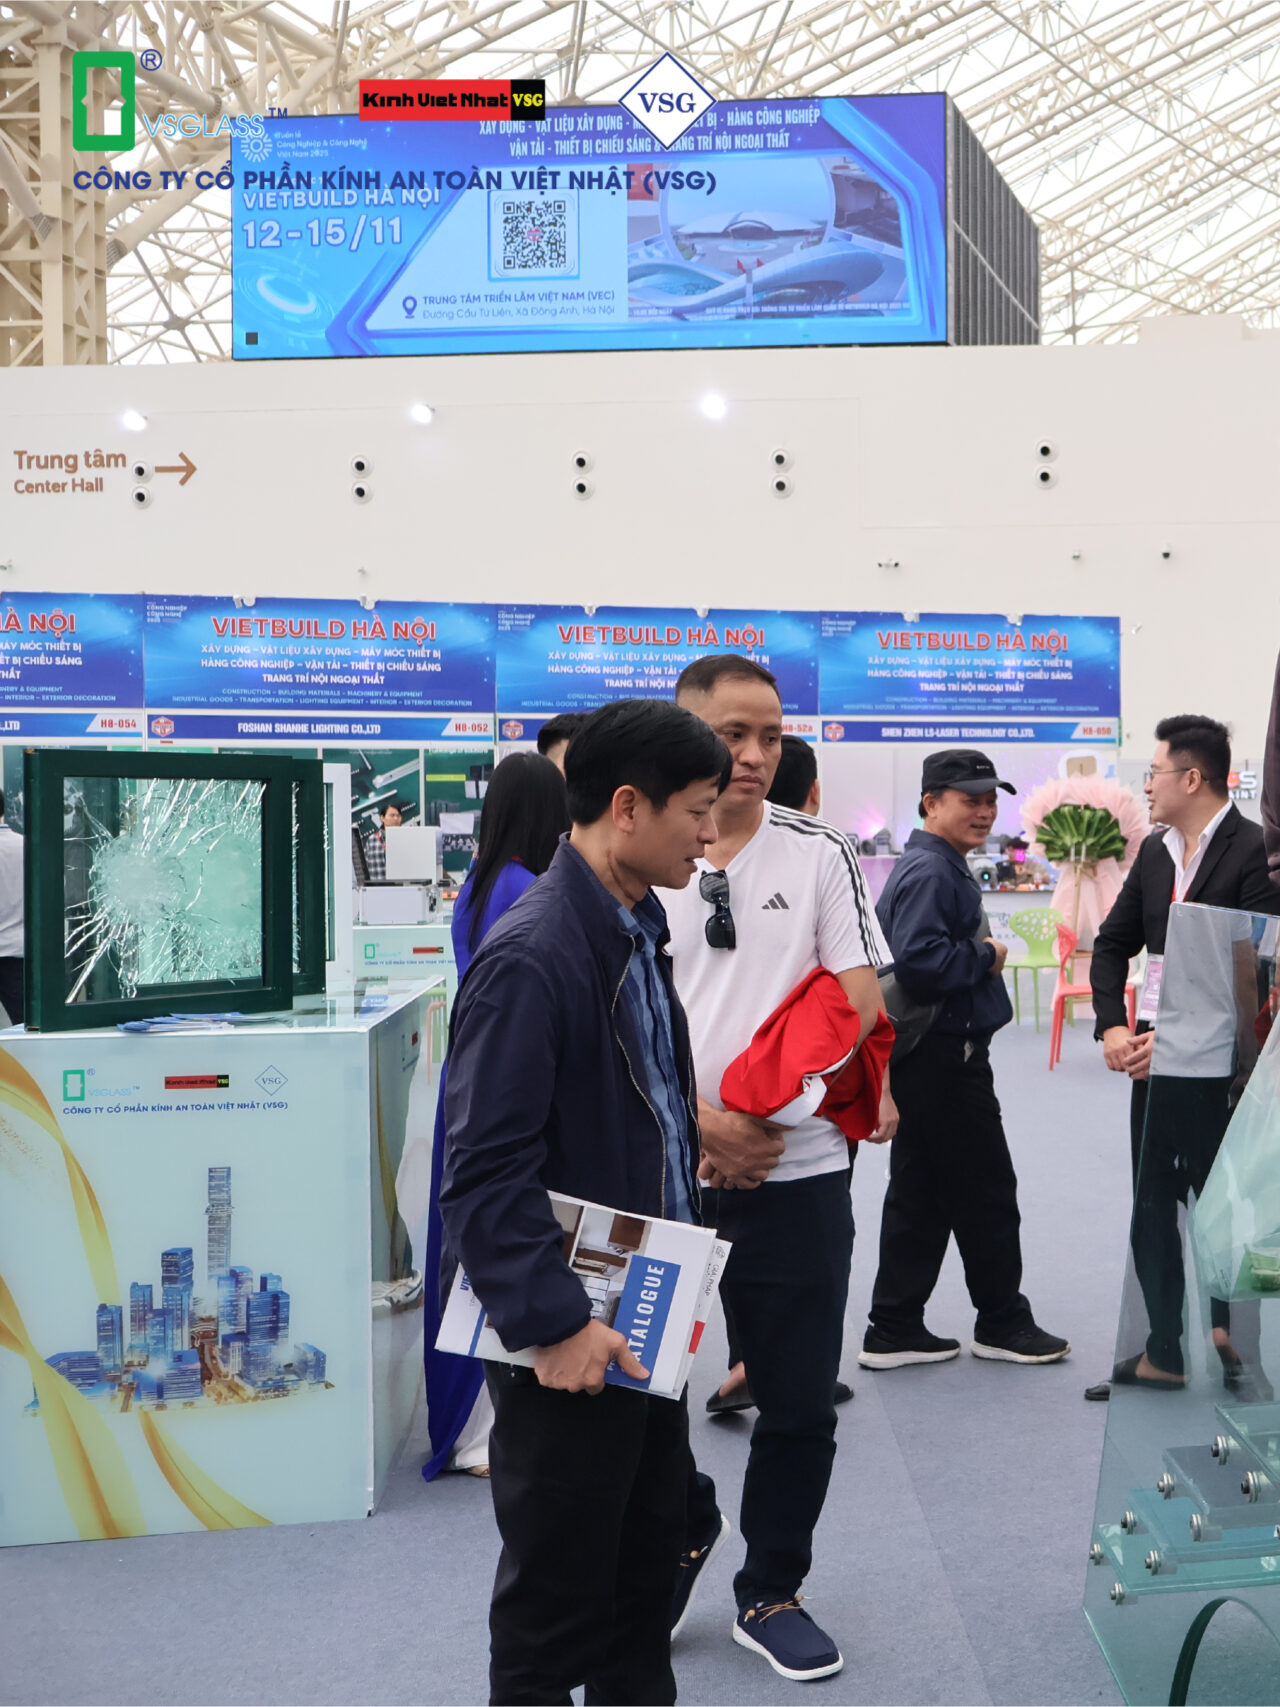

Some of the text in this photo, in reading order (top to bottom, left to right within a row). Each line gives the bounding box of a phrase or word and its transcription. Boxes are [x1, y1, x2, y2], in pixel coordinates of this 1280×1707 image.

[554, 117, 575, 138] LIỆU
[577, 113, 596, 132] XÂY
[597, 112, 623, 134] DỰNG
[707, 111, 717, 128] BỊ
[727, 107, 753, 126] HÀNG
[756, 107, 782, 126] CÔNG
[785, 106, 821, 126] NGHIỆP
[510, 130, 790, 160] VẬN TẢI THIẾT BỊ CHIẾU SÁNG TRÍ NỘI NGOẠI THẤT
[243, 182, 440, 209] VIETBUILD HÀ NỘI
[242, 213, 402, 252] 12-15/11
[422, 290, 615, 305] TRUNG TÂM TRIỂN LÃM VIỆT NAM (VEC)
[530, 305, 558, 318] Đông
[559, 304, 581, 317] Anh,
[583, 303, 596, 316] Hà
[598, 302, 615, 316] Nội
[14, 449, 127, 474] Trung tâm
[14, 477, 104, 494] Center Hall
[28, 608, 77, 639] NỘI
[211, 615, 437, 647] VIETBUILD HÀ NỘI
[557, 621, 765, 652] VIETBUILD HÀ NỘI
[877, 628, 1068, 657] VIETBUILD HÀ NỘI
[20, 639, 82, 653] MÓC THIẾT BỊ
[201, 643, 221, 654] XÂY
[224, 645, 250, 656] DỰNG
[280, 646, 300, 657] LIỆU
[303, 646, 322, 656] XÂY
[325, 647, 352, 658] DỰNG
[361, 646, 381, 657] MÁY
[383, 646, 405, 657] MÓC
[407, 645, 431, 658] THIẾT
[433, 649, 441, 660] BỊ
[12, 656, 21, 666] BỊ
[23, 653, 53, 665] CHIẾU
[55, 654, 83, 666] SÁNG
[201, 658, 442, 672] HÀNG CÔNG NGHIỆP VẬN TẢI THIẾT BỊ CHIẾU SÁNG
[262, 672, 385, 687] TRANG TRÍ NỘI NGOẠI THẤT
[238, 722, 272, 733] FOSHAN
[274, 722, 309, 734] SHANHE
[311, 723, 349, 735] LIGHTING
[455, 722, 488, 732] H8-052
[261, 1077, 282, 1086] VSG
[63, 1100, 289, 1115] CÔNG TY CỔ PHẦN KÍNH AN TOÀN VIỆT NHẬT (VSG)
[628, 1264, 665, 1365] ATALOGUE
